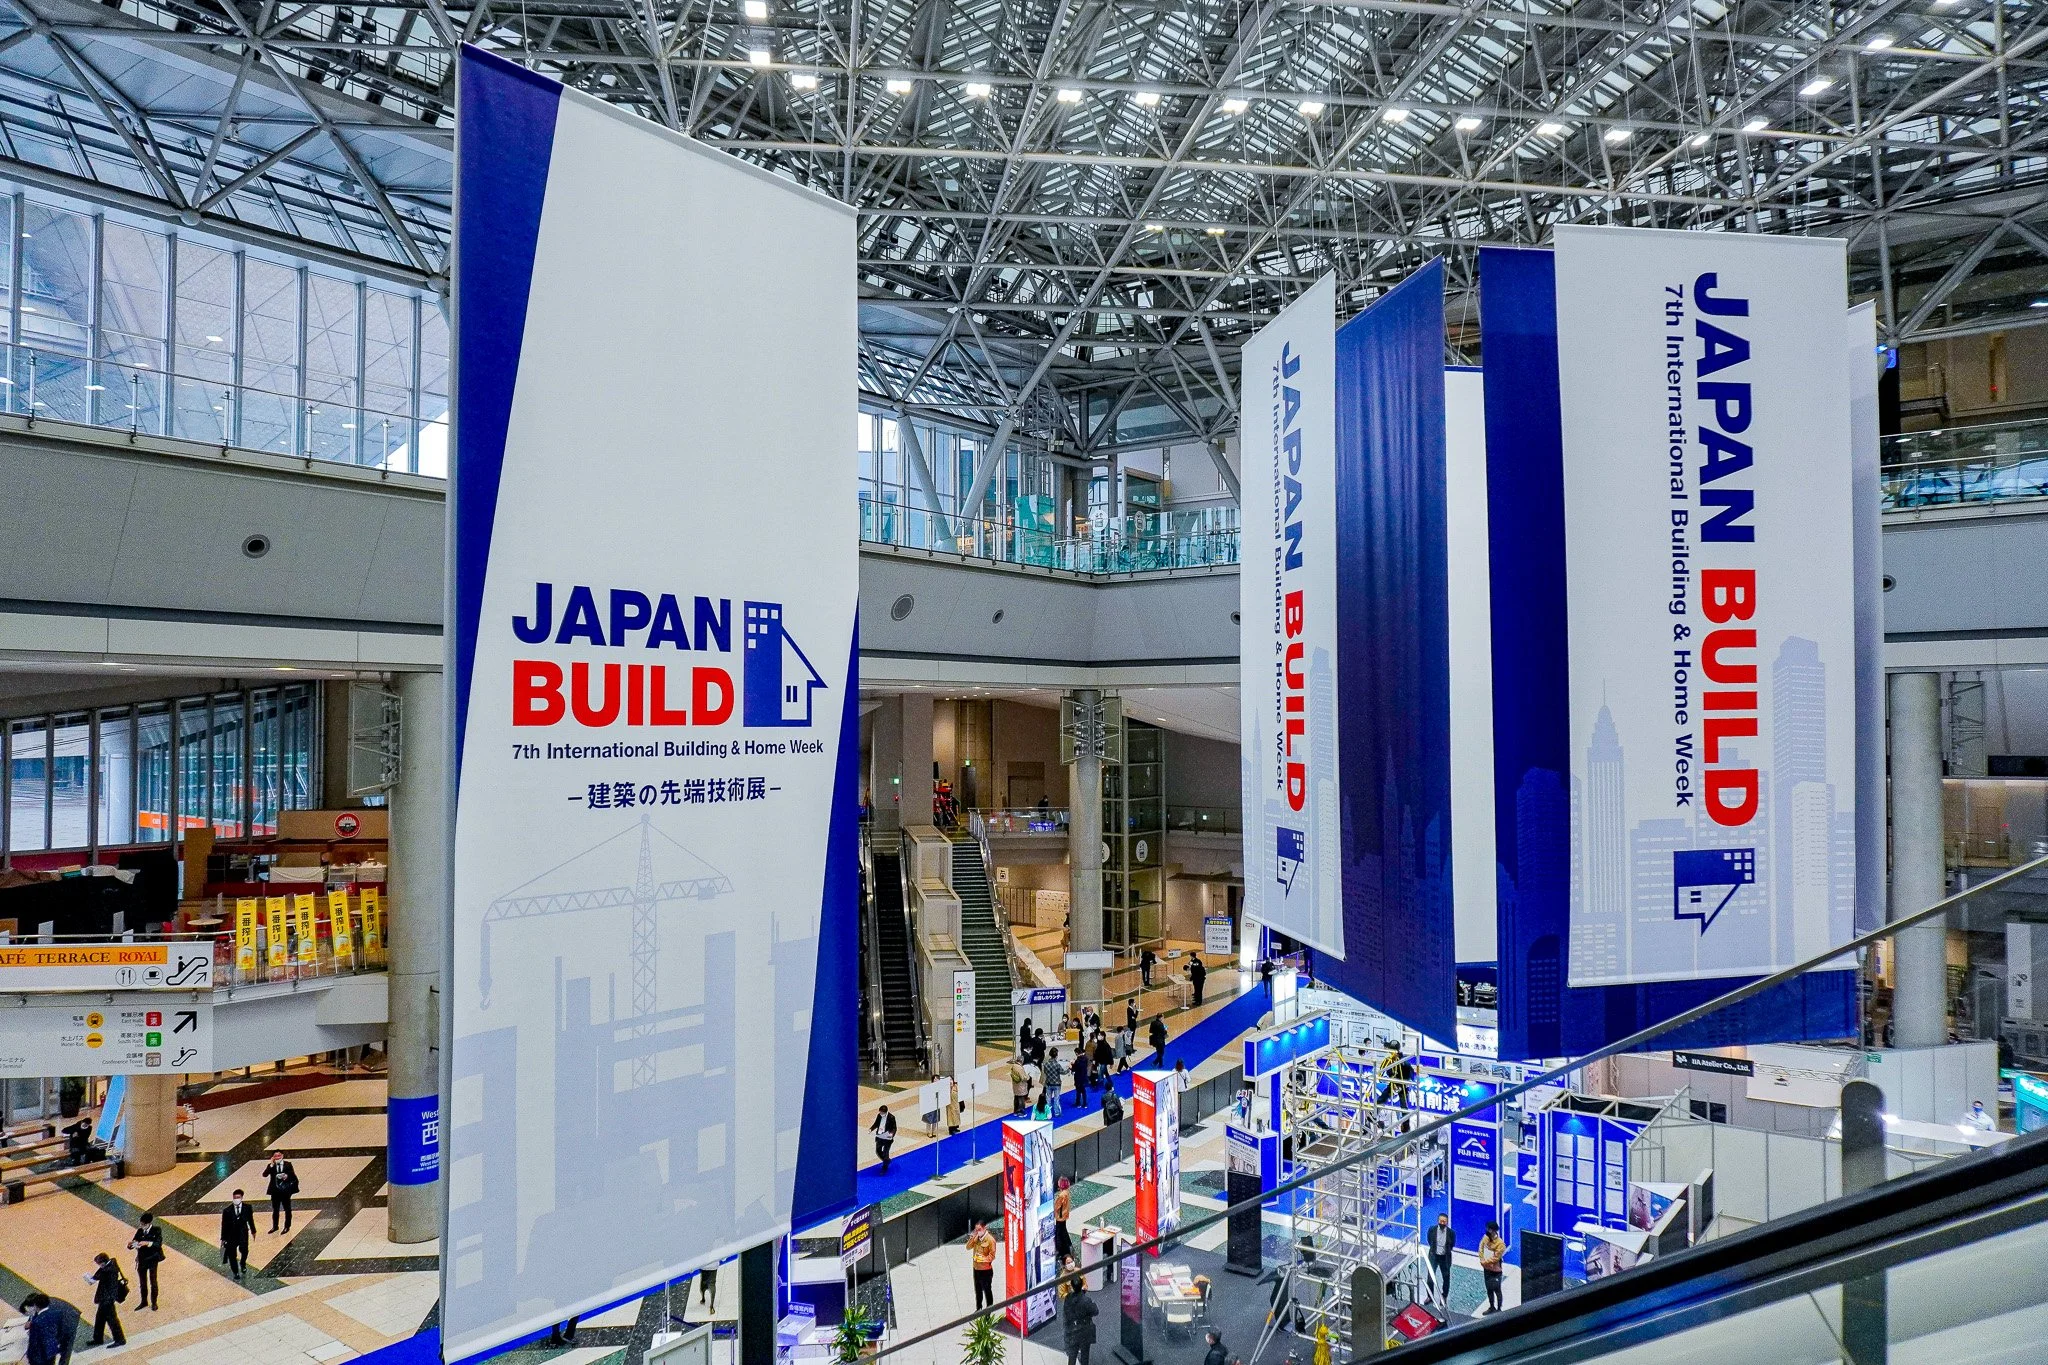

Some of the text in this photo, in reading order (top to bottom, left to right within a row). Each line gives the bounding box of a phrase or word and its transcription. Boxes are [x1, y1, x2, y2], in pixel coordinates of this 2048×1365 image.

[1665, 284, 1694, 807] 7th International Building & Home Week
[1694, 273, 1758, 826] JAPAN BUILD
[1272, 360, 1285, 790] 7th International Building & Home Week
[1281, 341, 1305, 811] JAPAN BUILD
[512, 582, 731, 652] JAPAN
[513, 660, 734, 727] BUILD
[512, 739, 824, 760] 7th International Building & Home Week
[242, 913, 251, 946] 一番搾り
[272, 910, 281, 943] 一番搾り
[300, 907, 310, 940] 一番搾り
[334, 903, 344, 935] 一番搾り
[366, 900, 375, 932] 一番搾り
[34, 952, 110, 964] TERRACE
[119, 952, 161, 962] ROYAL
[1737, 1064, 1751, 1072] Ltd.
[422, 1120, 439, 1145] 西
[1457, 1148, 1490, 1160] FUJI FINES
